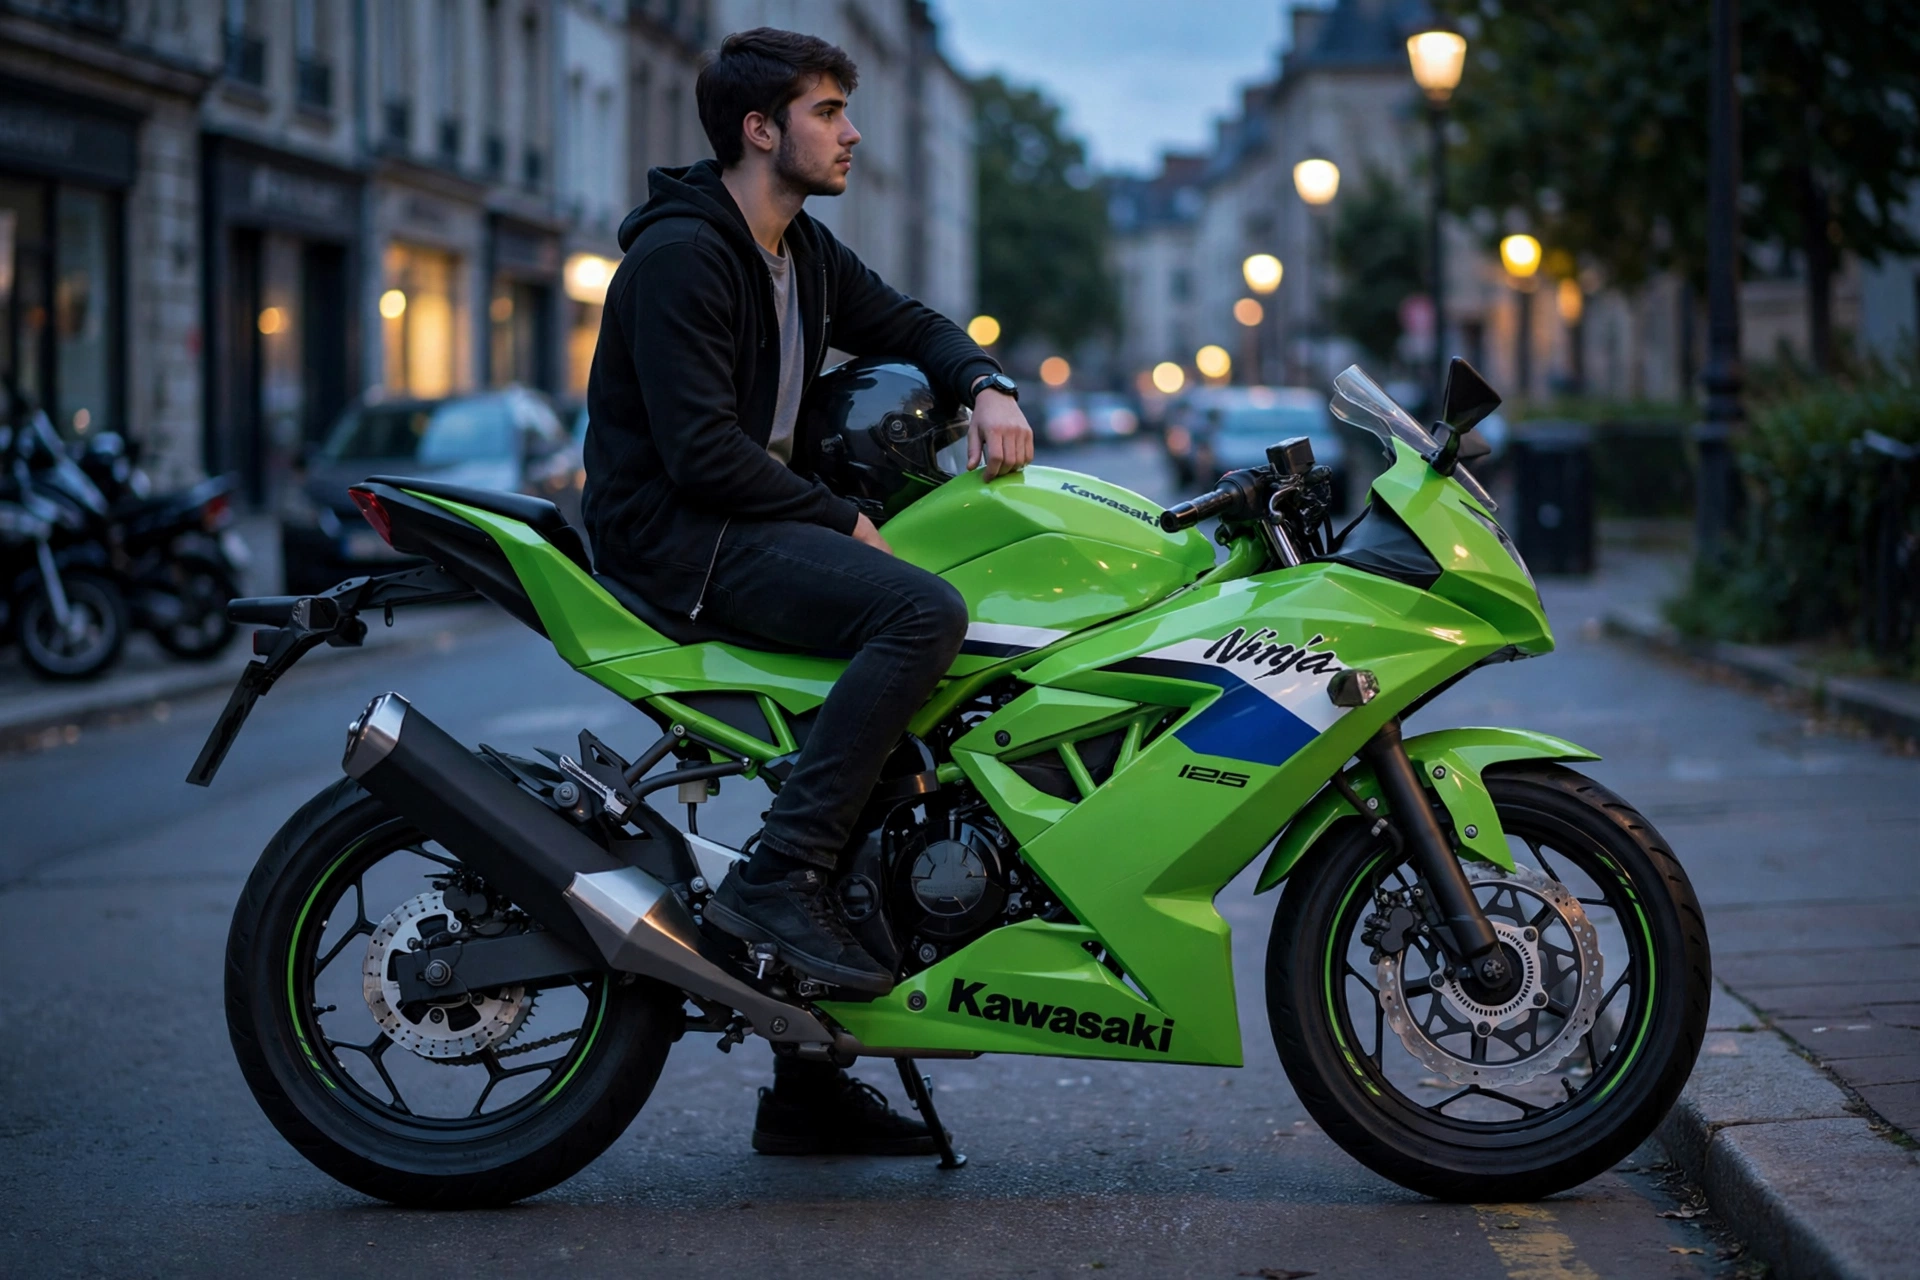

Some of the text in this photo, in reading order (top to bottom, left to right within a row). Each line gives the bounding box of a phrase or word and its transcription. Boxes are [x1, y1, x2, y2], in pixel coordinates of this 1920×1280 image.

[1060, 482, 1161, 528] Kawasaki
[1203, 627, 1342, 681] Ninja
[1178, 764, 1250, 788] 125
[948, 978, 1175, 1053] Kawasaki
